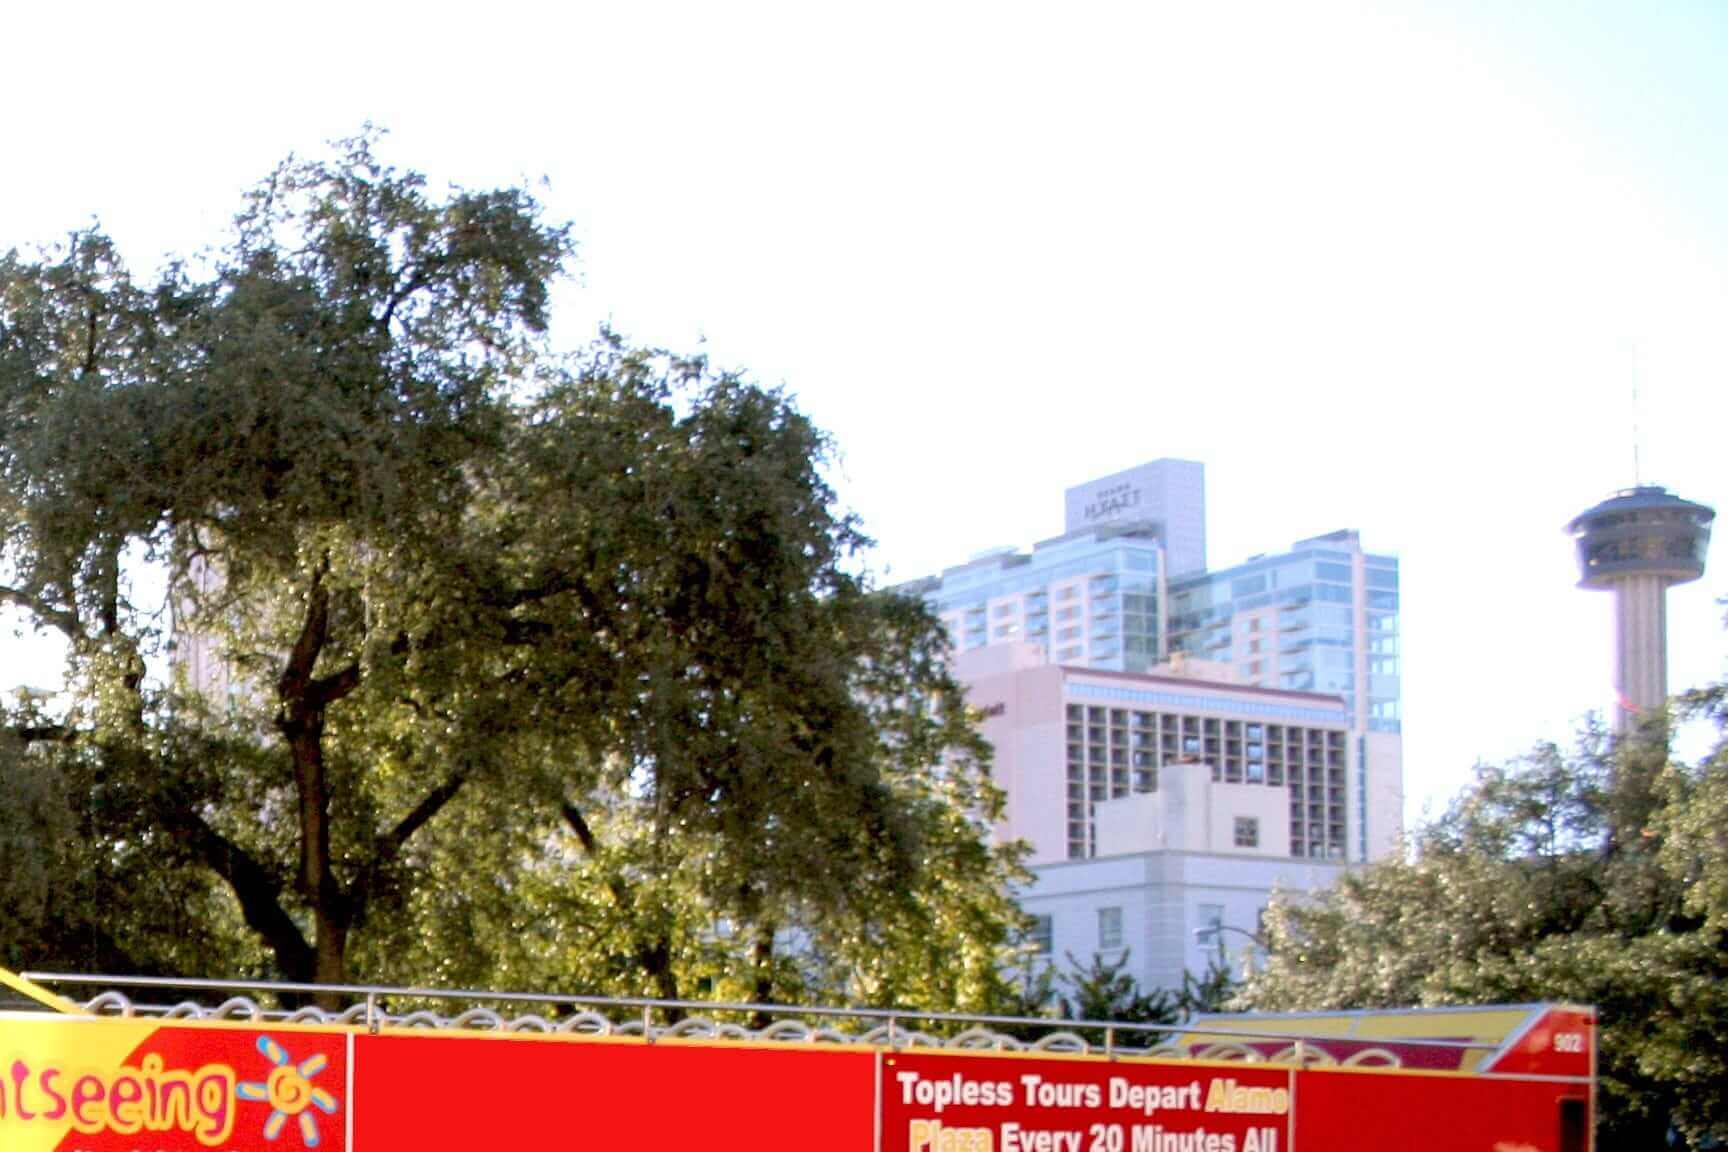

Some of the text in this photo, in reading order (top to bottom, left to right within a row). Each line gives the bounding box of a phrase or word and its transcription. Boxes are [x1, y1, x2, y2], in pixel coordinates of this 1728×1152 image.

[896, 1071, 1290, 1116] Topless Tours Depart Alamo
